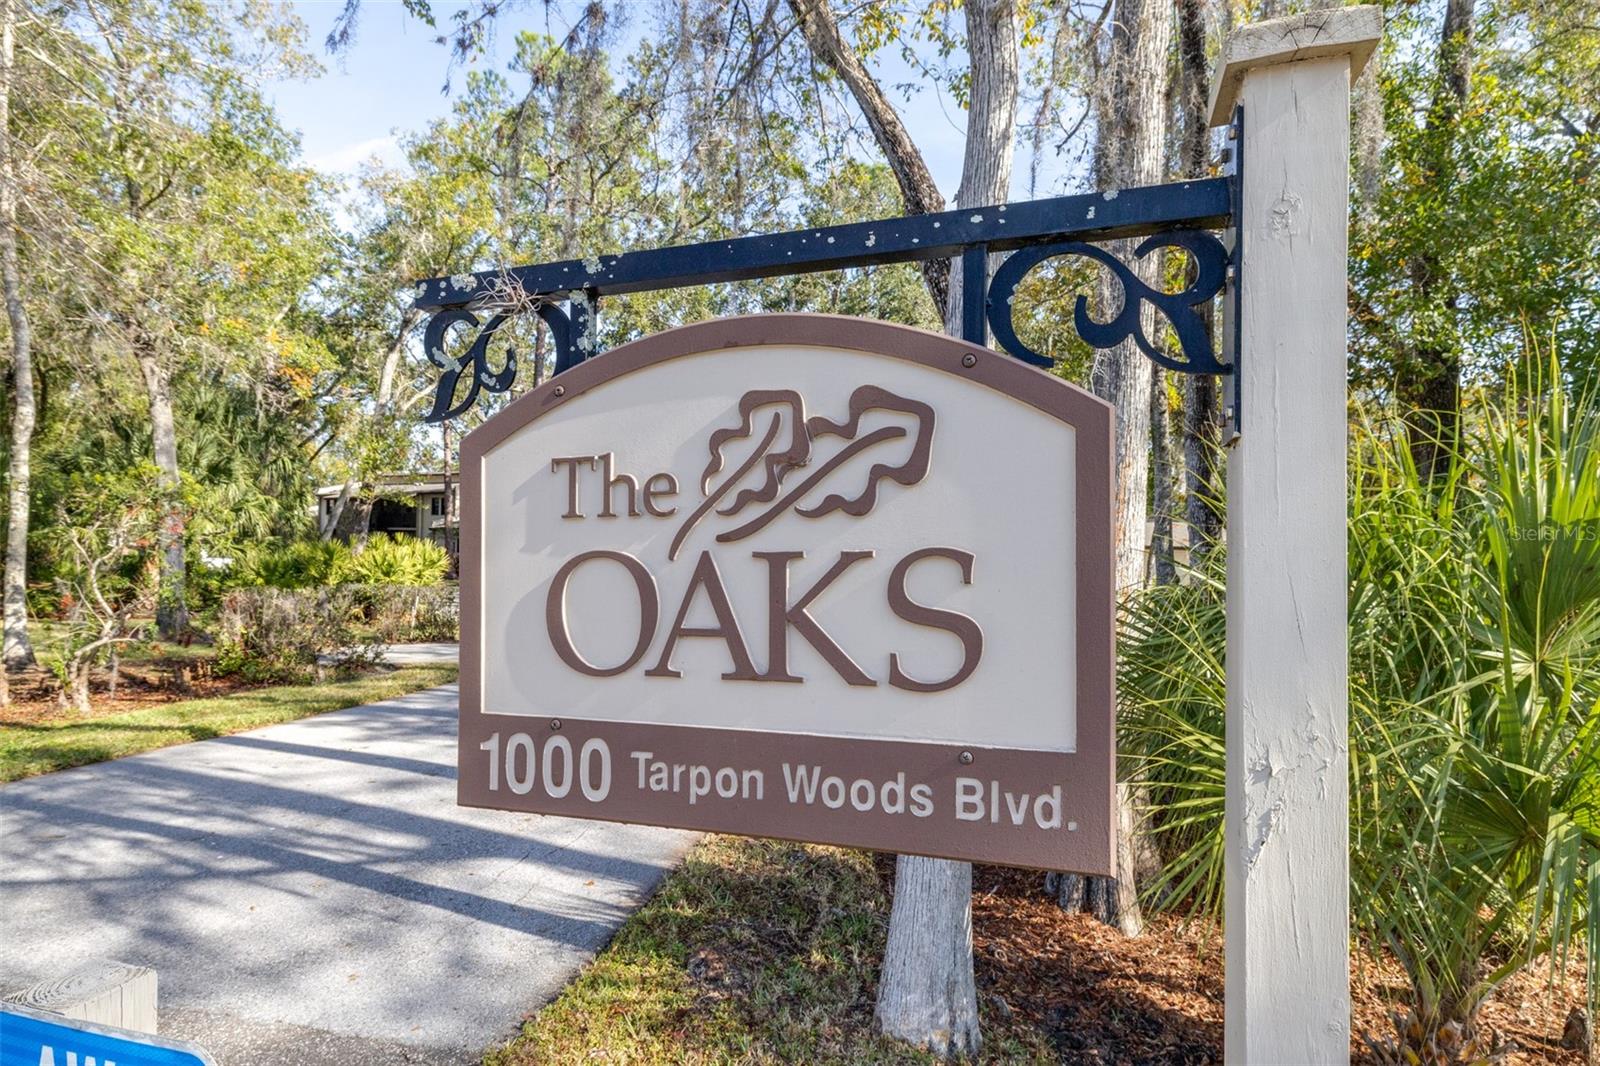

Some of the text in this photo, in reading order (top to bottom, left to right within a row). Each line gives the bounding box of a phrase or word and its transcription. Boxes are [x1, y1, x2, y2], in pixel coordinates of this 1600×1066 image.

[551, 452, 679, 519] The
[545, 547, 985, 693] OAKS
[480, 732, 1078, 832] 1000 Tarpon Woods Blvd.
